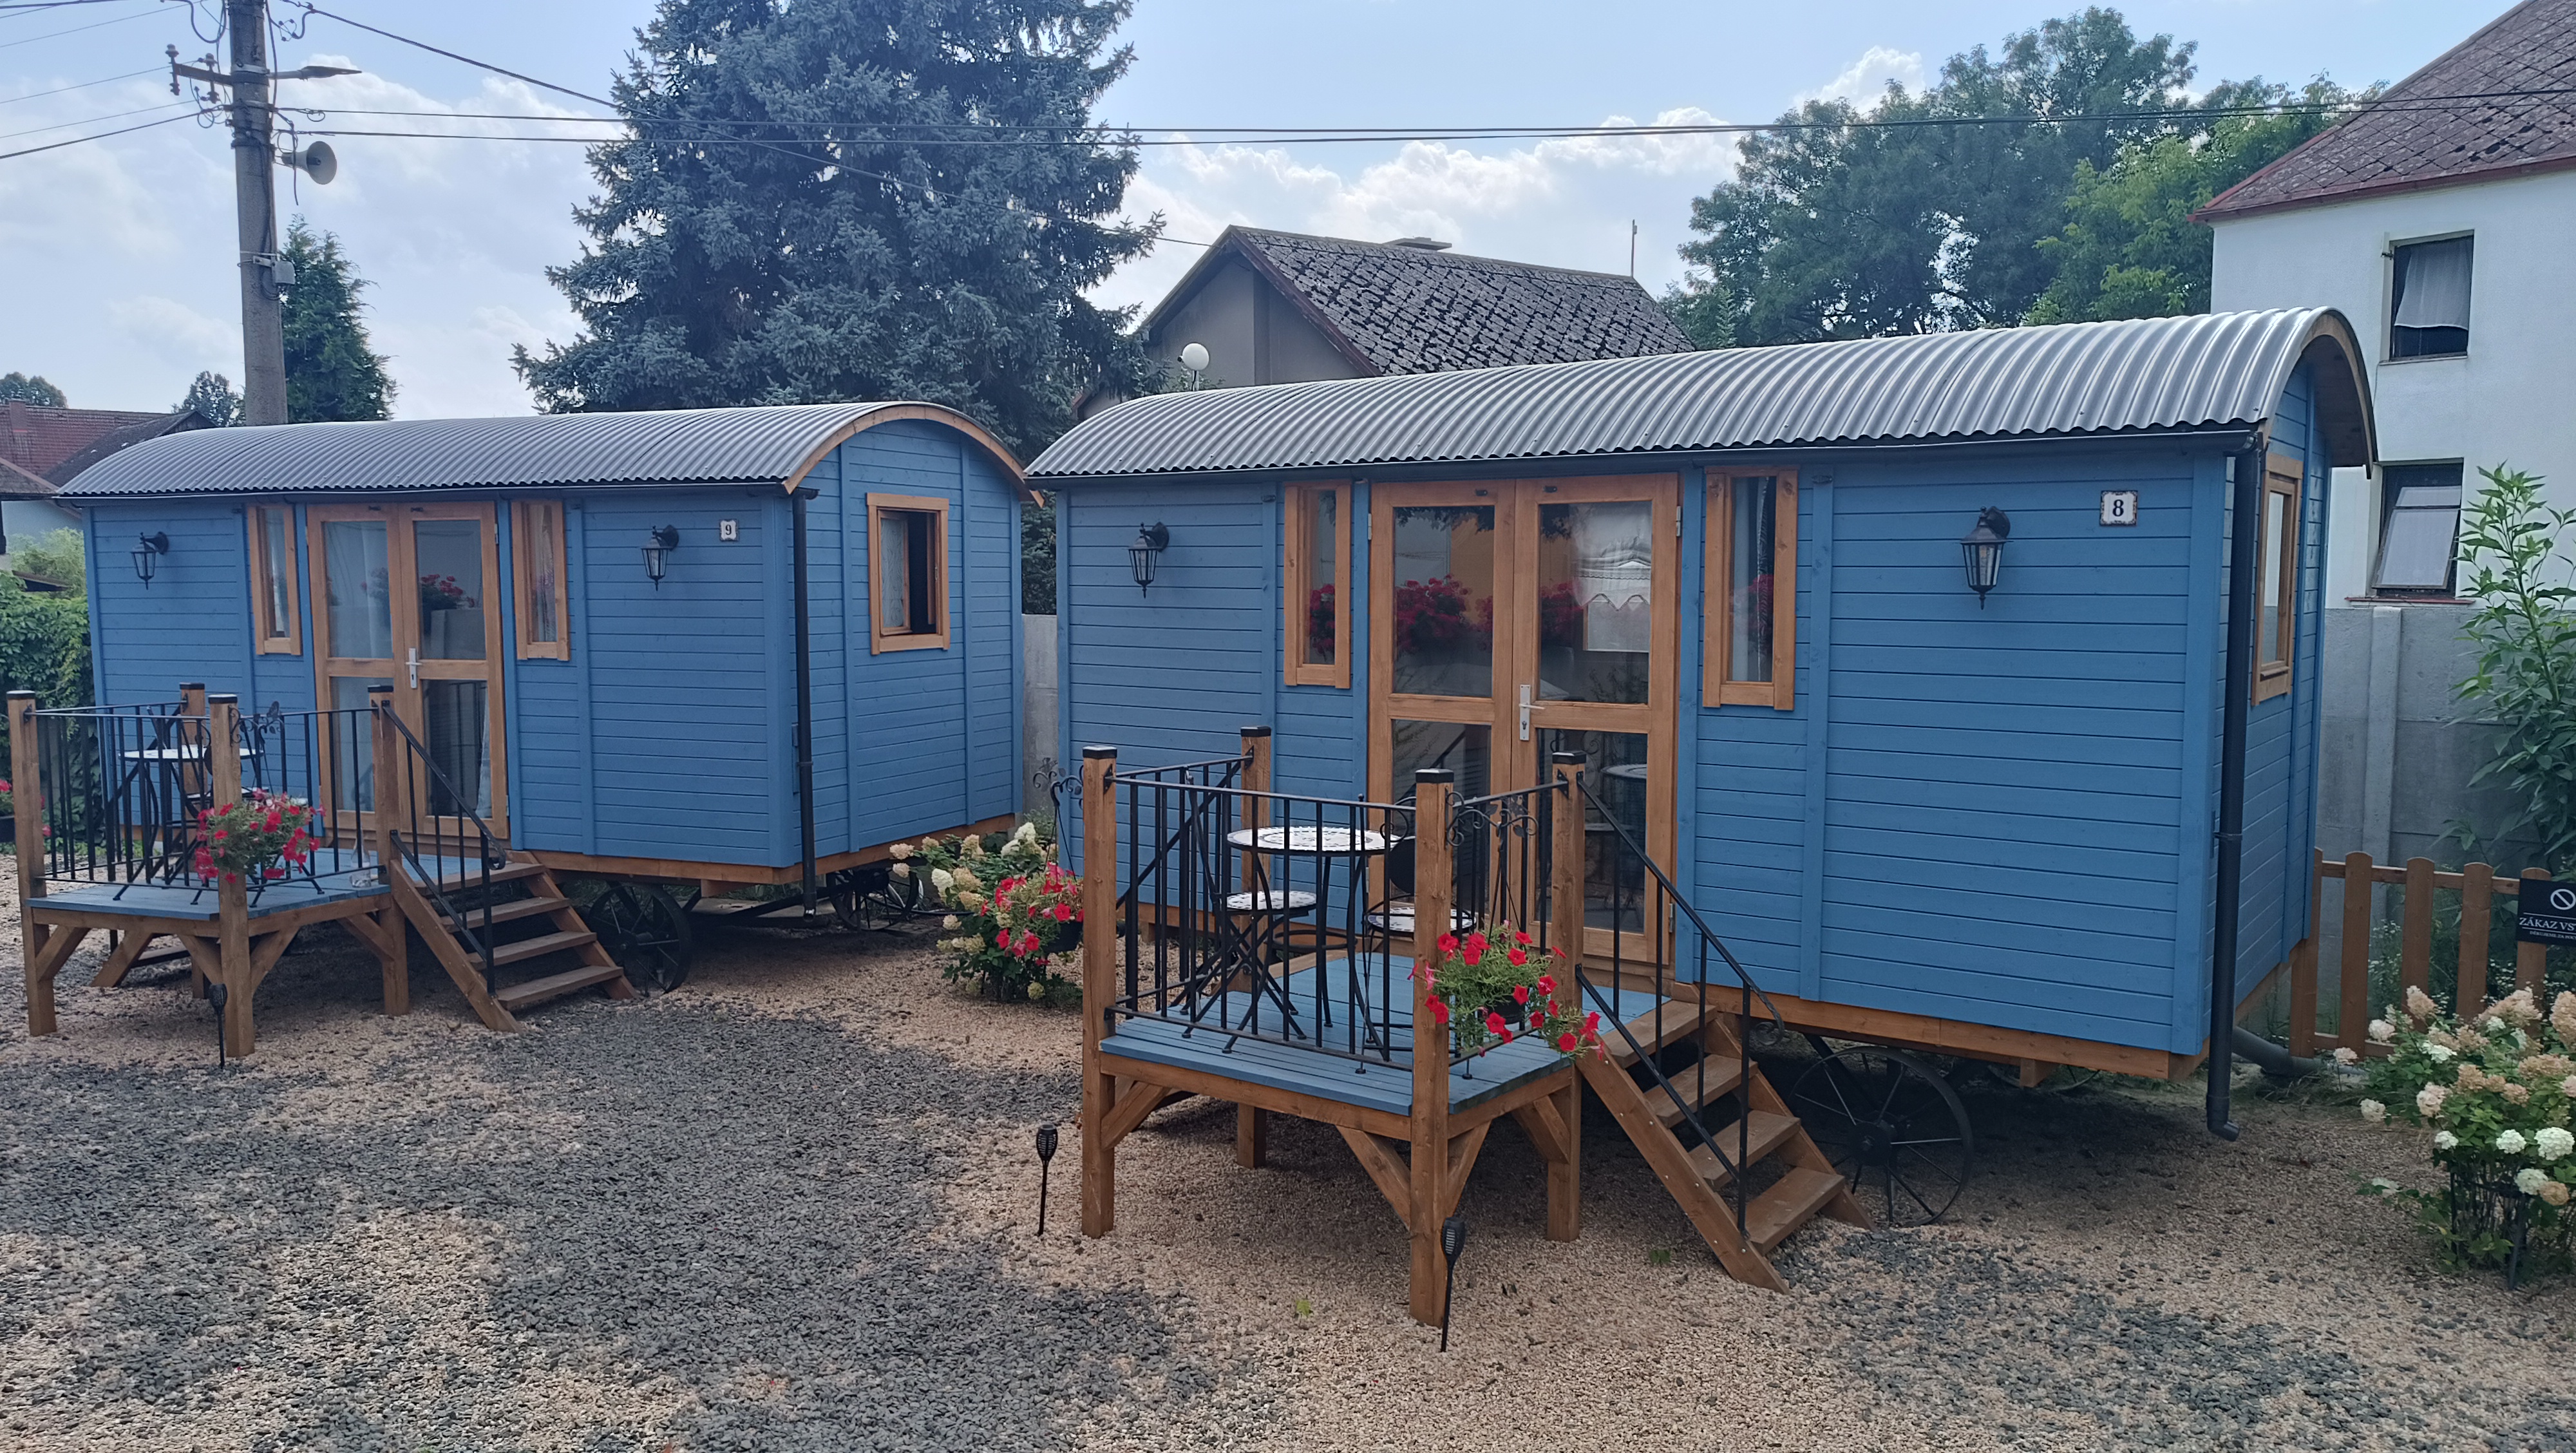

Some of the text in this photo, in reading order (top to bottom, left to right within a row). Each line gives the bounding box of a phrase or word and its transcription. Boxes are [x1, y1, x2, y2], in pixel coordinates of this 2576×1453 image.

[2112, 499, 2124, 517] 8
[725, 524, 732, 536] 9
[2519, 916, 2558, 929] ZÁKAZ
